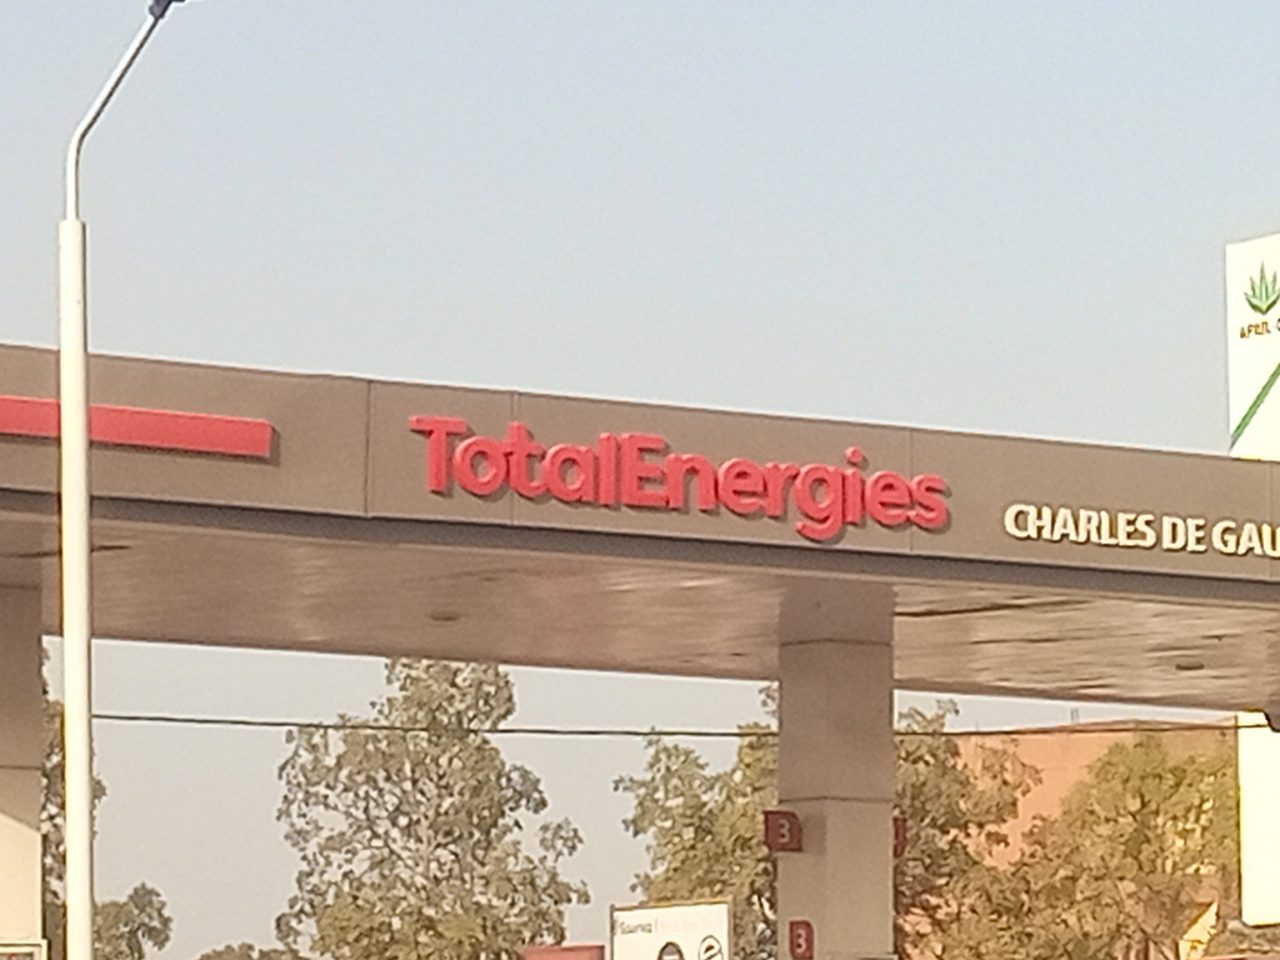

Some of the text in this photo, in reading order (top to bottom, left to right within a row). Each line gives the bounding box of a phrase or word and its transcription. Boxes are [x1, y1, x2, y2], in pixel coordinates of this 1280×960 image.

[408, 415, 949, 541] TotalEnergies
[1004, 503, 1158, 549] CHARLES
[1162, 515, 1206, 552] DE
[779, 819, 791, 843] 3
[796, 928, 807, 953] 3
